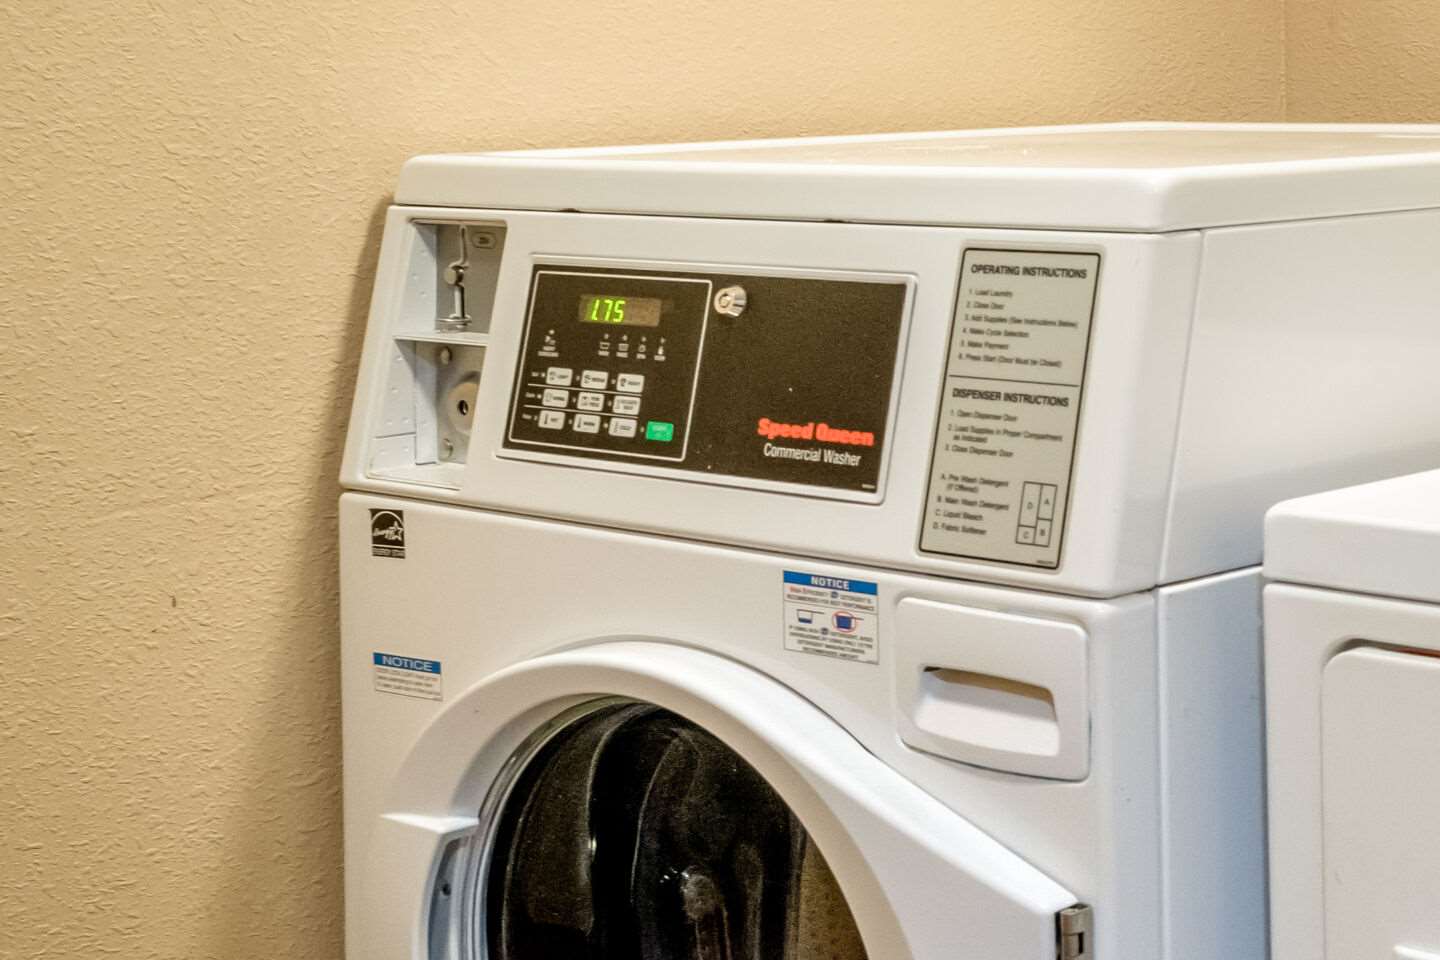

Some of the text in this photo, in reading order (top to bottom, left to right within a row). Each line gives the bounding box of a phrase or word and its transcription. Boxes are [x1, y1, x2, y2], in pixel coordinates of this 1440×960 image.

[971, 264, 1087, 279] OPERATING INSTRUCTIONS
[952, 388, 1069, 407] DISPENSER INSTRUCTIONS
[757, 417, 875, 447] Speed Queen
[763, 442, 862, 467] Commercial Washer
[811, 576, 849, 590] NOTICE
[382, 655, 433, 672] NOTICE
